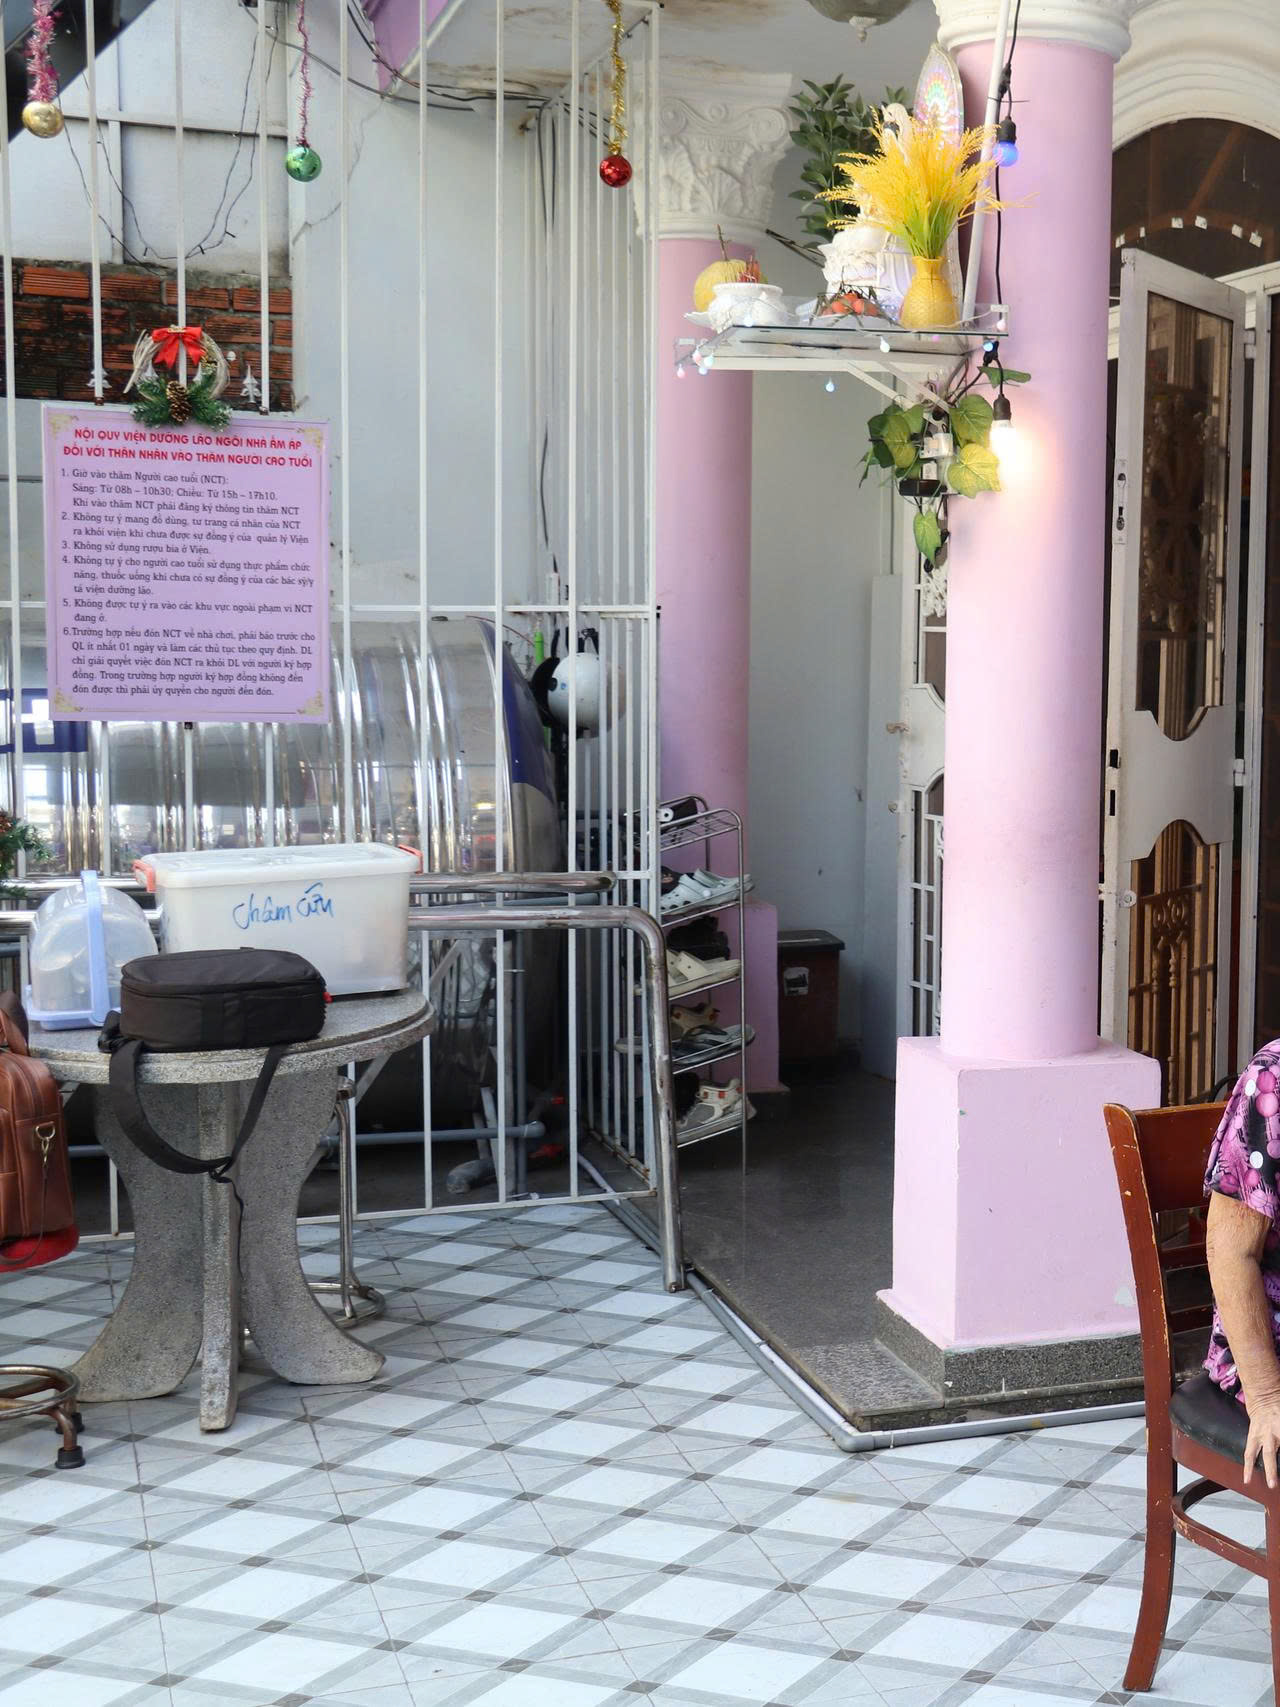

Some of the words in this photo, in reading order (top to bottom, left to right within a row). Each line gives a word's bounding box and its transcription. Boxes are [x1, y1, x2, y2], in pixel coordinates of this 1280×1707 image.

[74, 428, 94, 441] NỘI
[97, 430, 120, 441] QUY
[122, 430, 146, 444] VIỆN
[149, 432, 188, 444] DƯỠNG
[192, 434, 212, 445] LÃO
[215, 435, 242, 447] NGÔI
[246, 436, 267, 448] NHÀ
[269, 436, 286, 449] ẤM
[288, 439, 301, 450] ÁP
[63, 443, 83, 456] ĐỐI
[85, 446, 104, 457] VỚI
[107, 447, 135, 459] THÂN
[138, 448, 168, 460] NHÂN
[170, 450, 192, 462] VÀO
[195, 451, 224, 463] THĂM
[227, 453, 262, 465] NGƯỜI
[264, 456, 286, 466] CAO
[288, 454, 312, 468] TUỔI
[61, 468, 69, 477] 1.
[72, 468, 88, 478] Giờ
[90, 469, 106, 479] vào
[108, 470, 132, 480] thăm
[134, 471, 161, 483] Người
[180, 471, 198, 483] tuổi
[72, 498, 88, 507] Khi
[90, 498, 107, 507] vào
[109, 499, 132, 508] thăm
[135, 500, 154, 509] NCT
[156, 501, 176, 513] phải
[177, 502, 200, 514] đăng
[202, 503, 213, 514] ký
[214, 503, 240, 515] thông
[242, 505, 254, 514] tin
[256, 505, 278, 515] thăm
[280, 506, 298, 515] NCT
